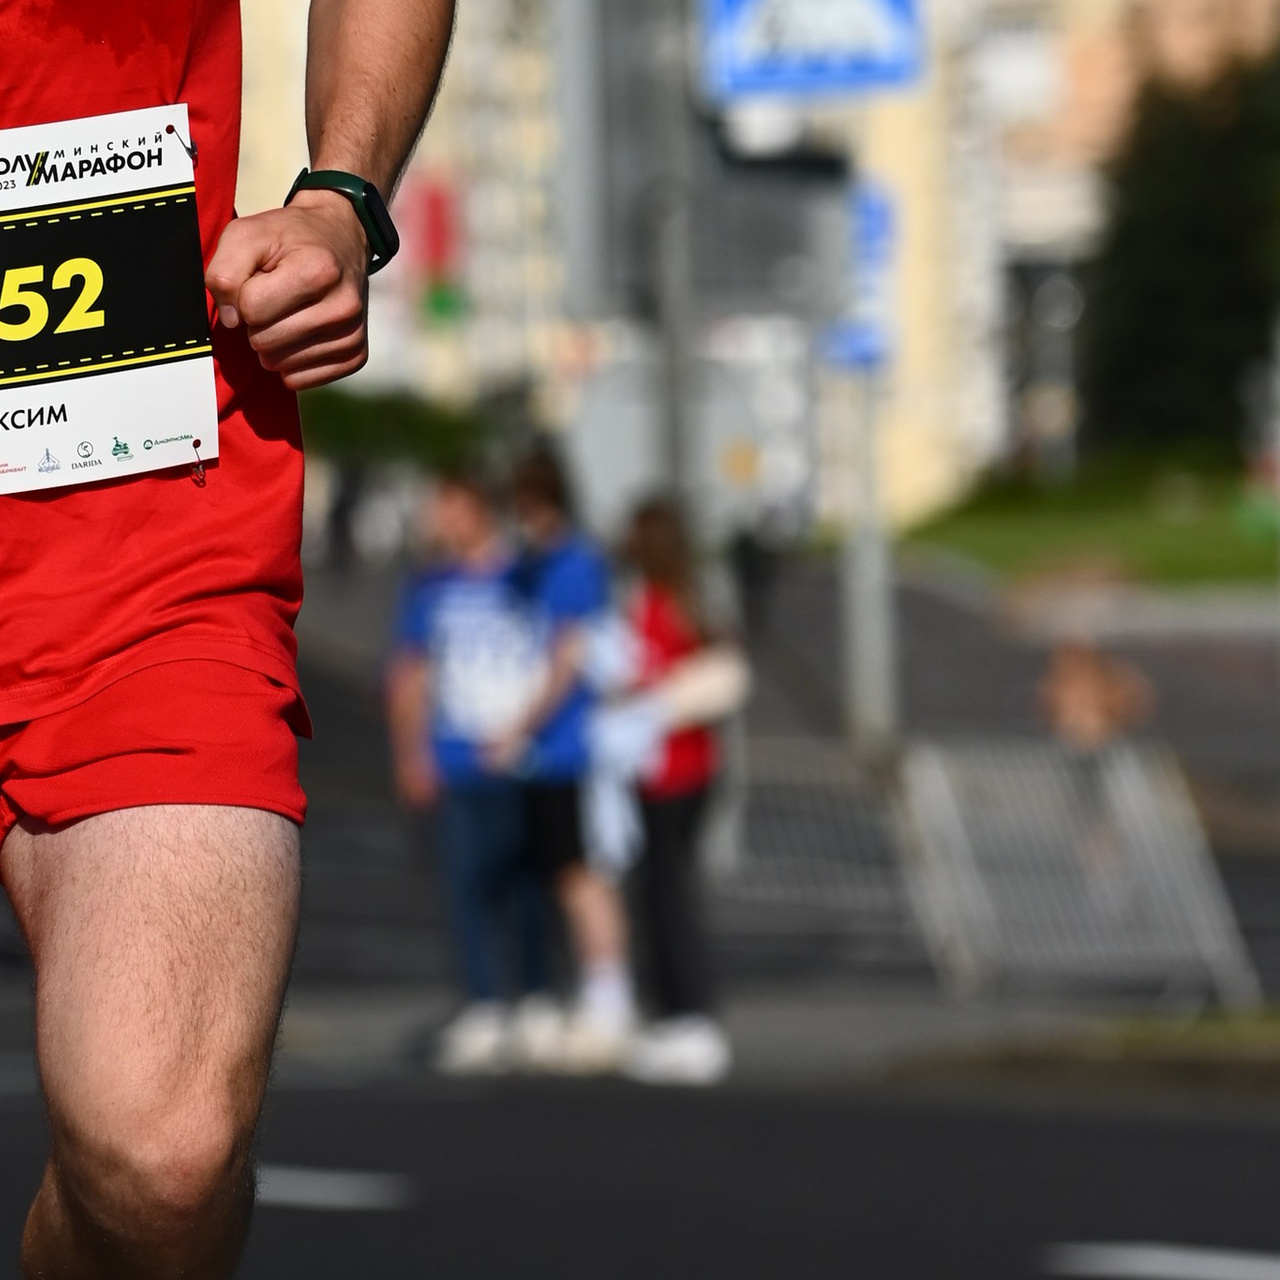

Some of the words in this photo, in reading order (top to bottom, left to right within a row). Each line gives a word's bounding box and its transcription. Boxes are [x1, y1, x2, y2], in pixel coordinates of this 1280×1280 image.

[54, 132, 163, 159] МИНСКИЙ
[34, 147, 163, 186] МАРАФОН
[71, 459, 103, 470] DARIDA
